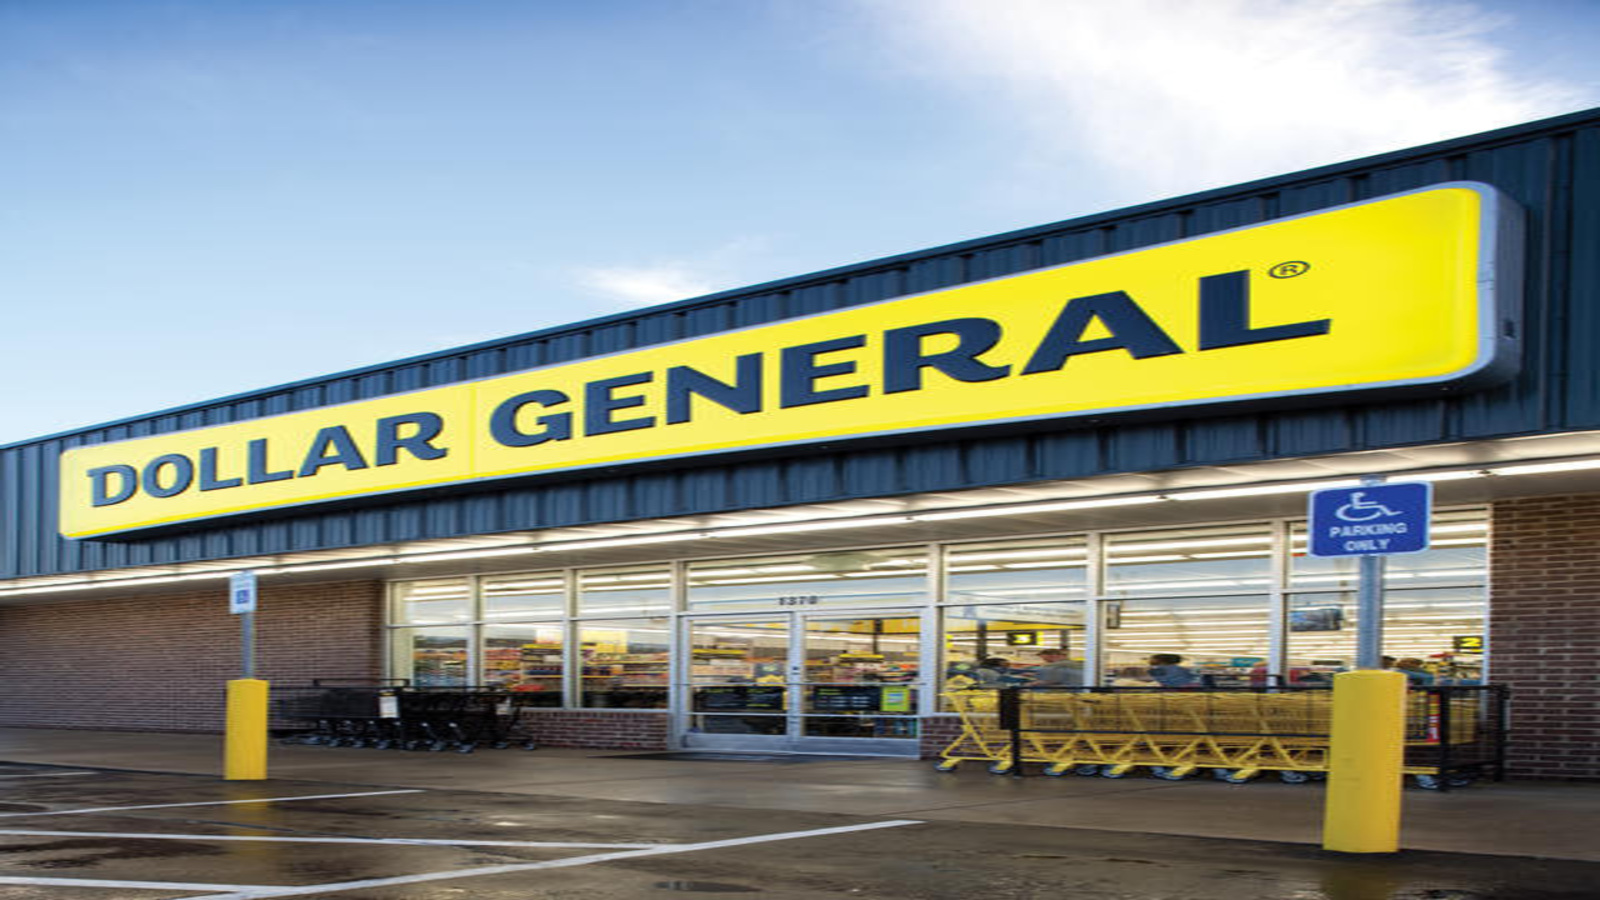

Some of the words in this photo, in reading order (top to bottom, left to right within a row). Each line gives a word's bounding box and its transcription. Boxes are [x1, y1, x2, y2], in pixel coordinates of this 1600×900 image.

[86, 411, 449, 507] DOLLAR
[489, 268, 1332, 448] GENERAL
[1329, 523, 1408, 537] PARKING
[1344, 539, 1391, 551] ONLY
[1460, 637, 1481, 647] 2
